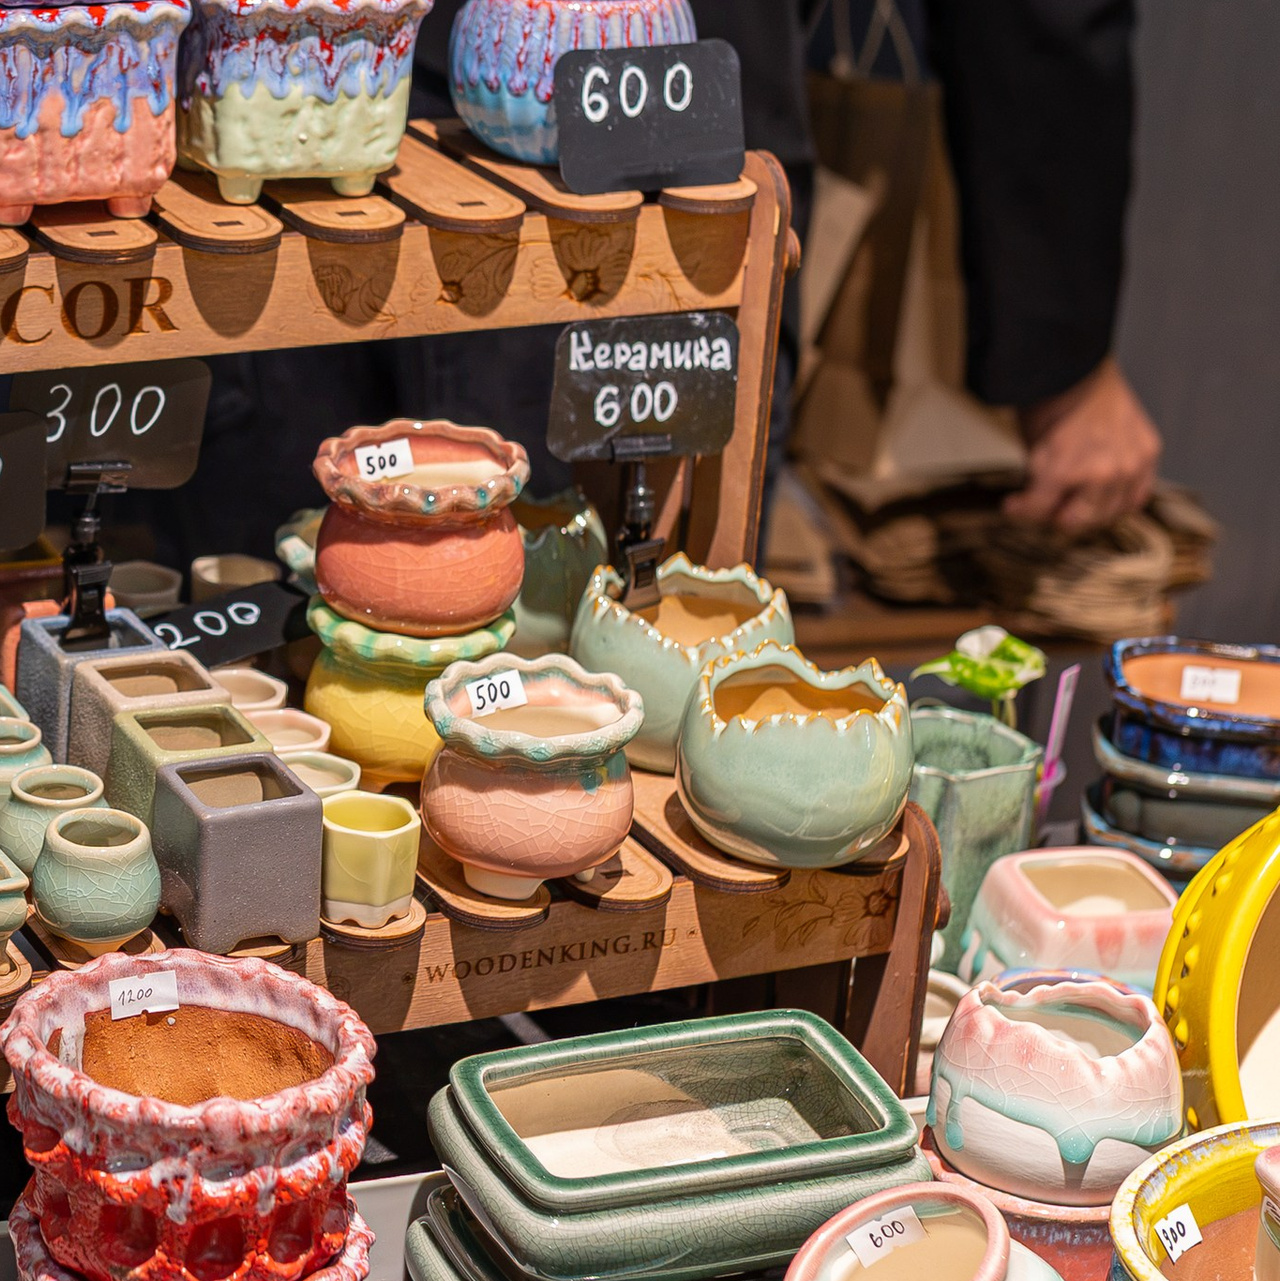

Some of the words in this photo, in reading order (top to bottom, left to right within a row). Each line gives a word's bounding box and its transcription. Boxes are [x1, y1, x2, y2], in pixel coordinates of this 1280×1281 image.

[582, 63, 693, 123] 600
[569, 330, 732, 371] Керамика
[46, 383, 166, 443] 300
[594, 381, 678, 427] 600
[366, 453, 397, 475] 500
[154, 601, 262, 650] 200
[476, 680, 510, 710] 500
[425, 927, 678, 984] WOODENKING.RU
[118, 987, 153, 1006] 1200
[869, 1220, 905, 1248] 600
[1162, 1221, 1186, 1251] 900
